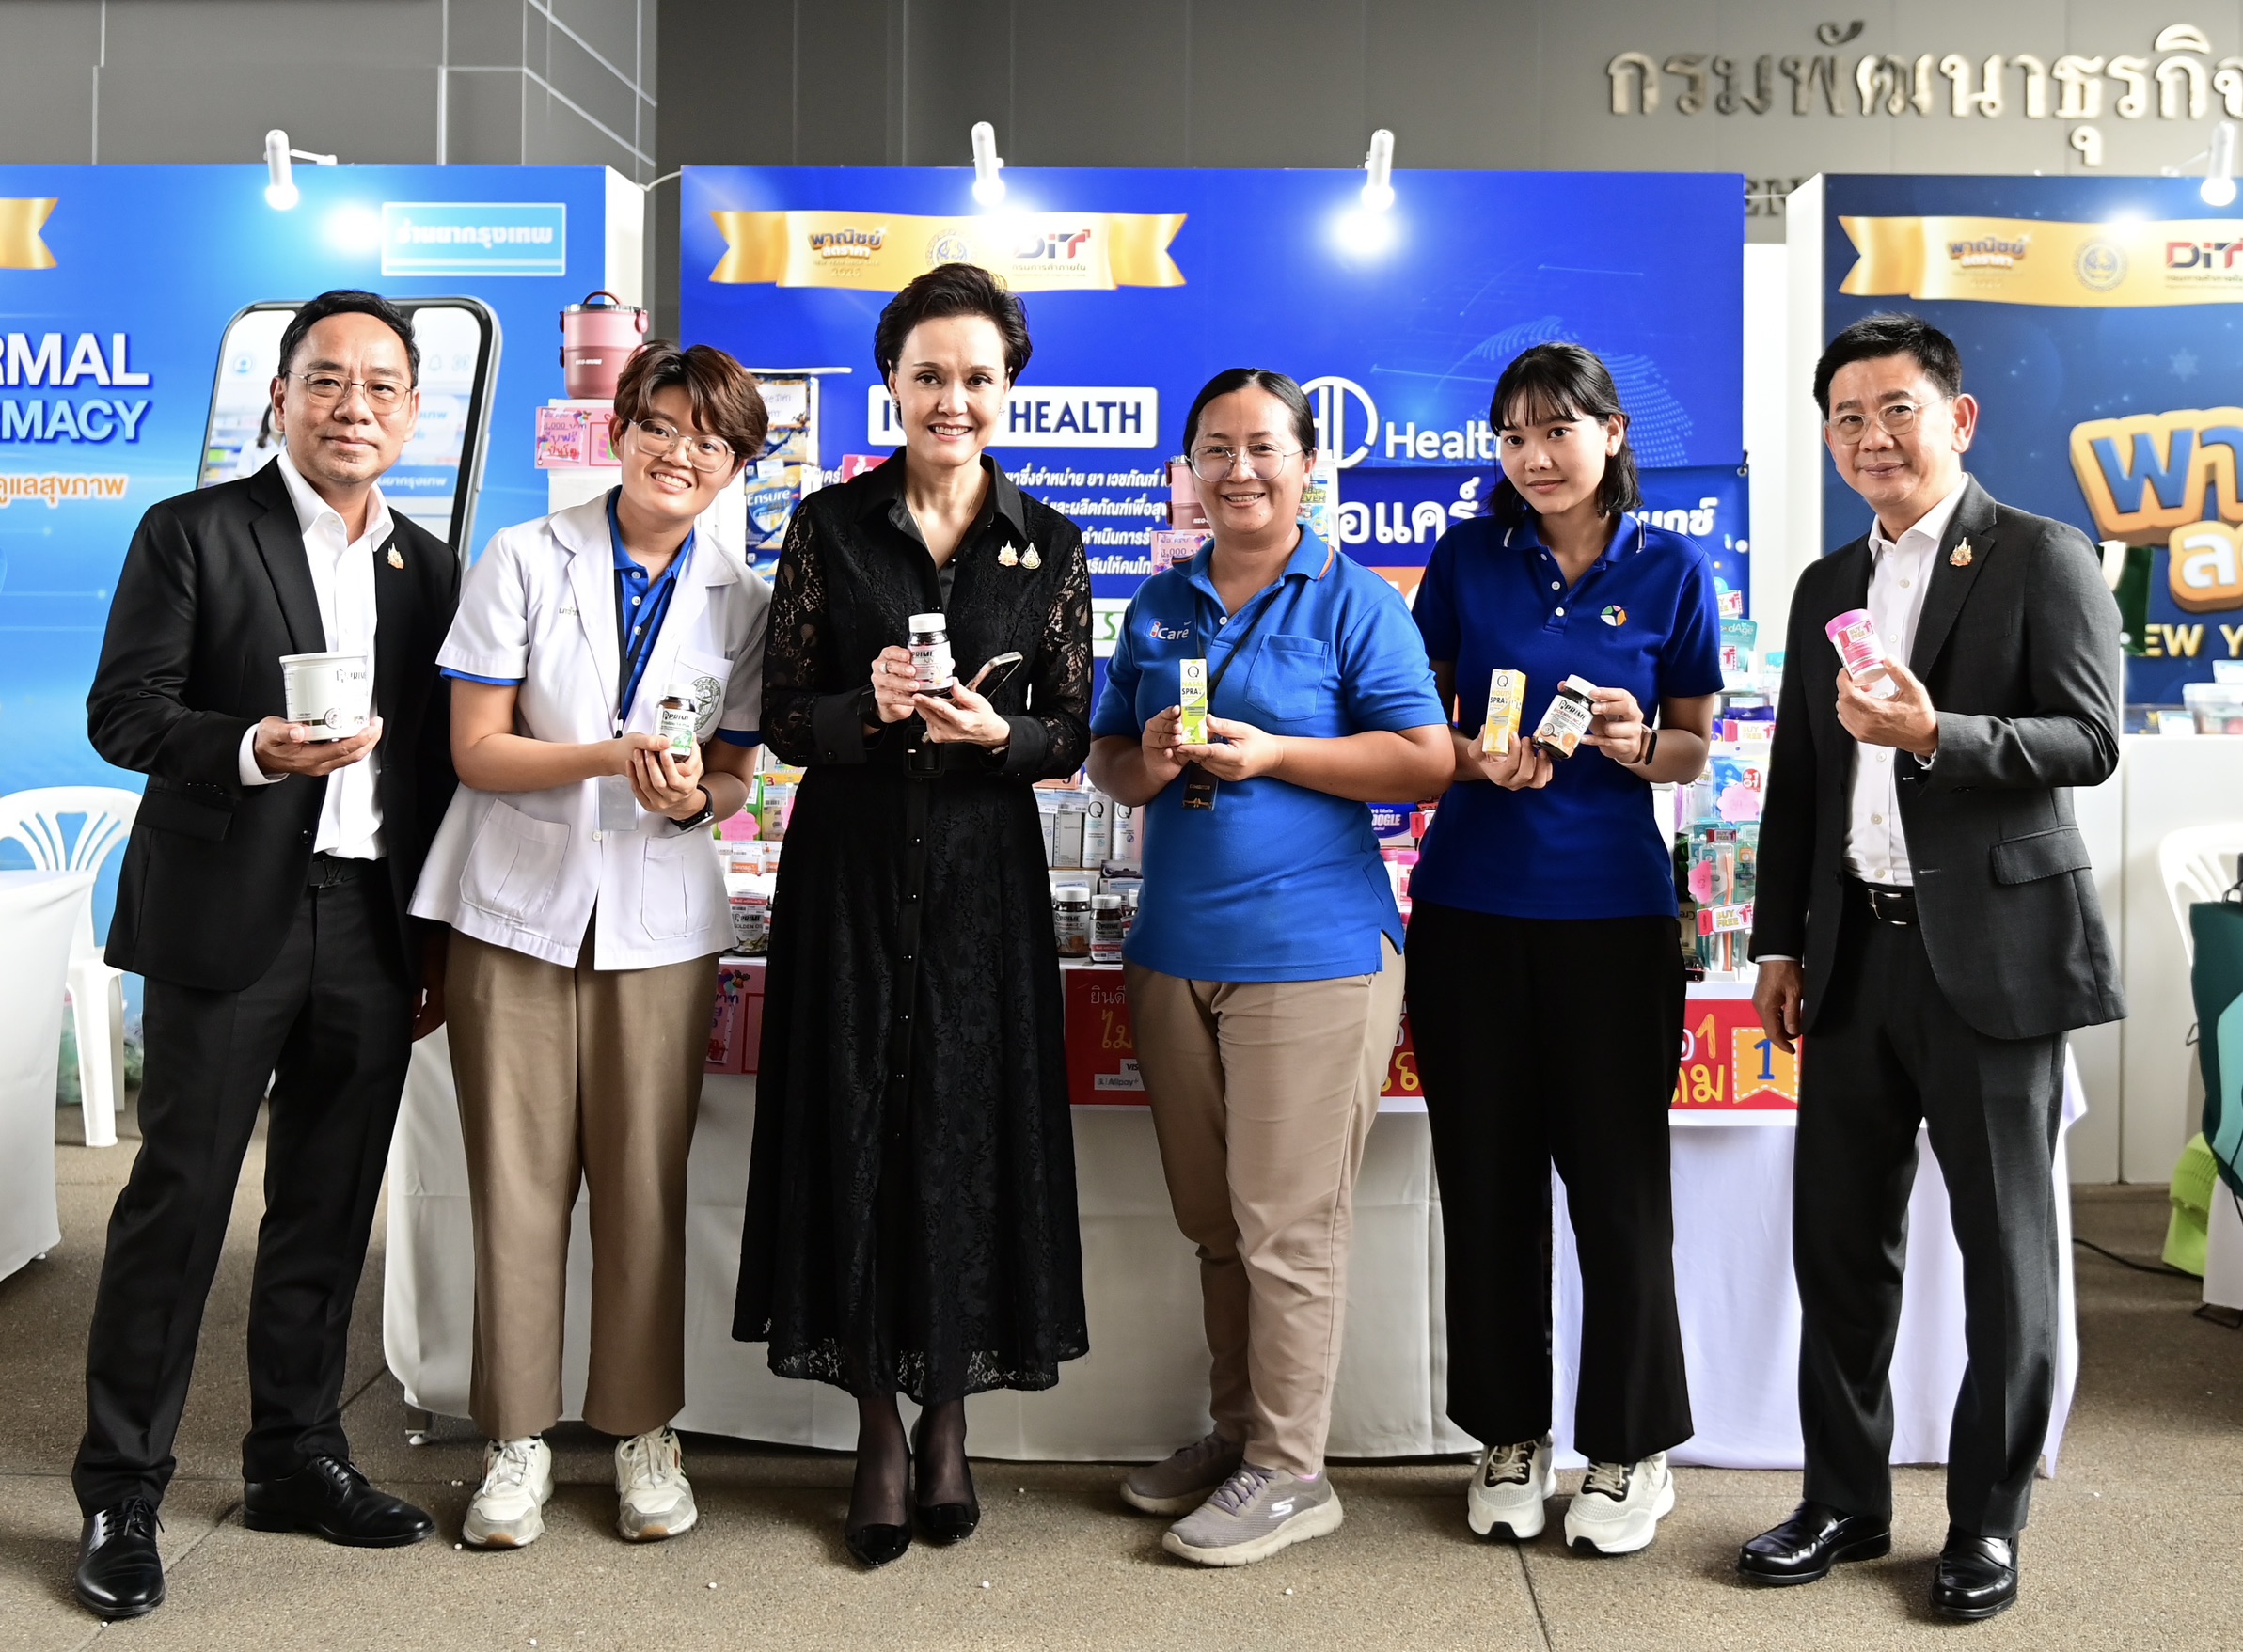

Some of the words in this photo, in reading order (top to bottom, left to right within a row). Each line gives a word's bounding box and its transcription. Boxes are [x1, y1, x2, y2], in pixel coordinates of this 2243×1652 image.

[812, 228, 882, 246] พาณิชย์
[0, 332, 150, 386] MAL
[1009, 400, 1142, 433] HEALTH
[1087, 472, 1104, 487] ยา
[1106, 467, 1161, 488] เวชภัณฑ์
[747, 489, 791, 506] Ensure
[1150, 621, 1190, 640] iCare
[2145, 623, 2204, 657] EW
[1187, 665, 1199, 679] Q
[1496, 675, 1508, 688] Q
[1088, 800, 1104, 819] Q
[1715, 909, 1734, 919] BUY
[1717, 918, 1739, 928] FREE
[1754, 1038, 1775, 1080] 1
